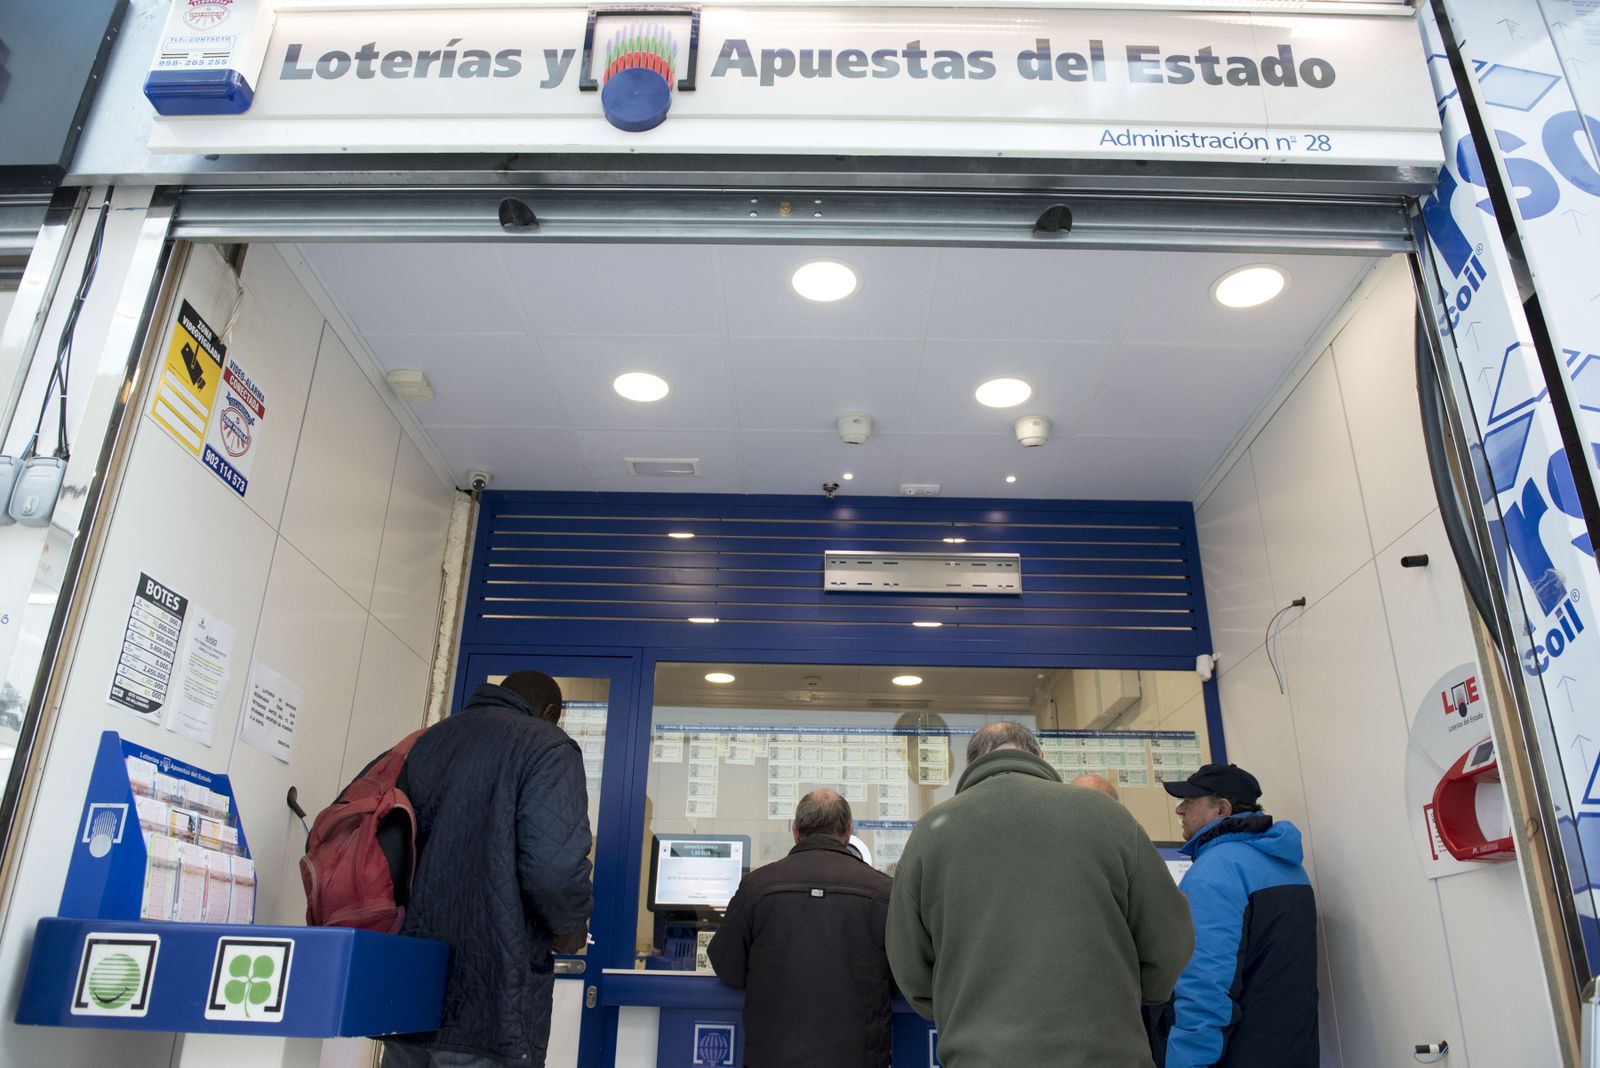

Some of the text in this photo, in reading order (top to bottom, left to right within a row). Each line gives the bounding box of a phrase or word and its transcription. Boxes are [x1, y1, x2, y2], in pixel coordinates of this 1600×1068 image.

[207, 58, 228, 66] 255
[279, 38, 1337, 91] Loterías y Apuestas del Estado
[1099, 126, 1270, 152] Administración
[1304, 134, 1332, 152] 28
[182, 315, 221, 363] VIDEOVIGILADA
[197, 320, 212, 341] ZONA
[230, 359, 265, 403] VIDEO-ALARMA
[230, 375, 259, 413] CONECTADA
[205, 449, 246, 492] 902 114 573
[145, 579, 180, 611] BOTES
